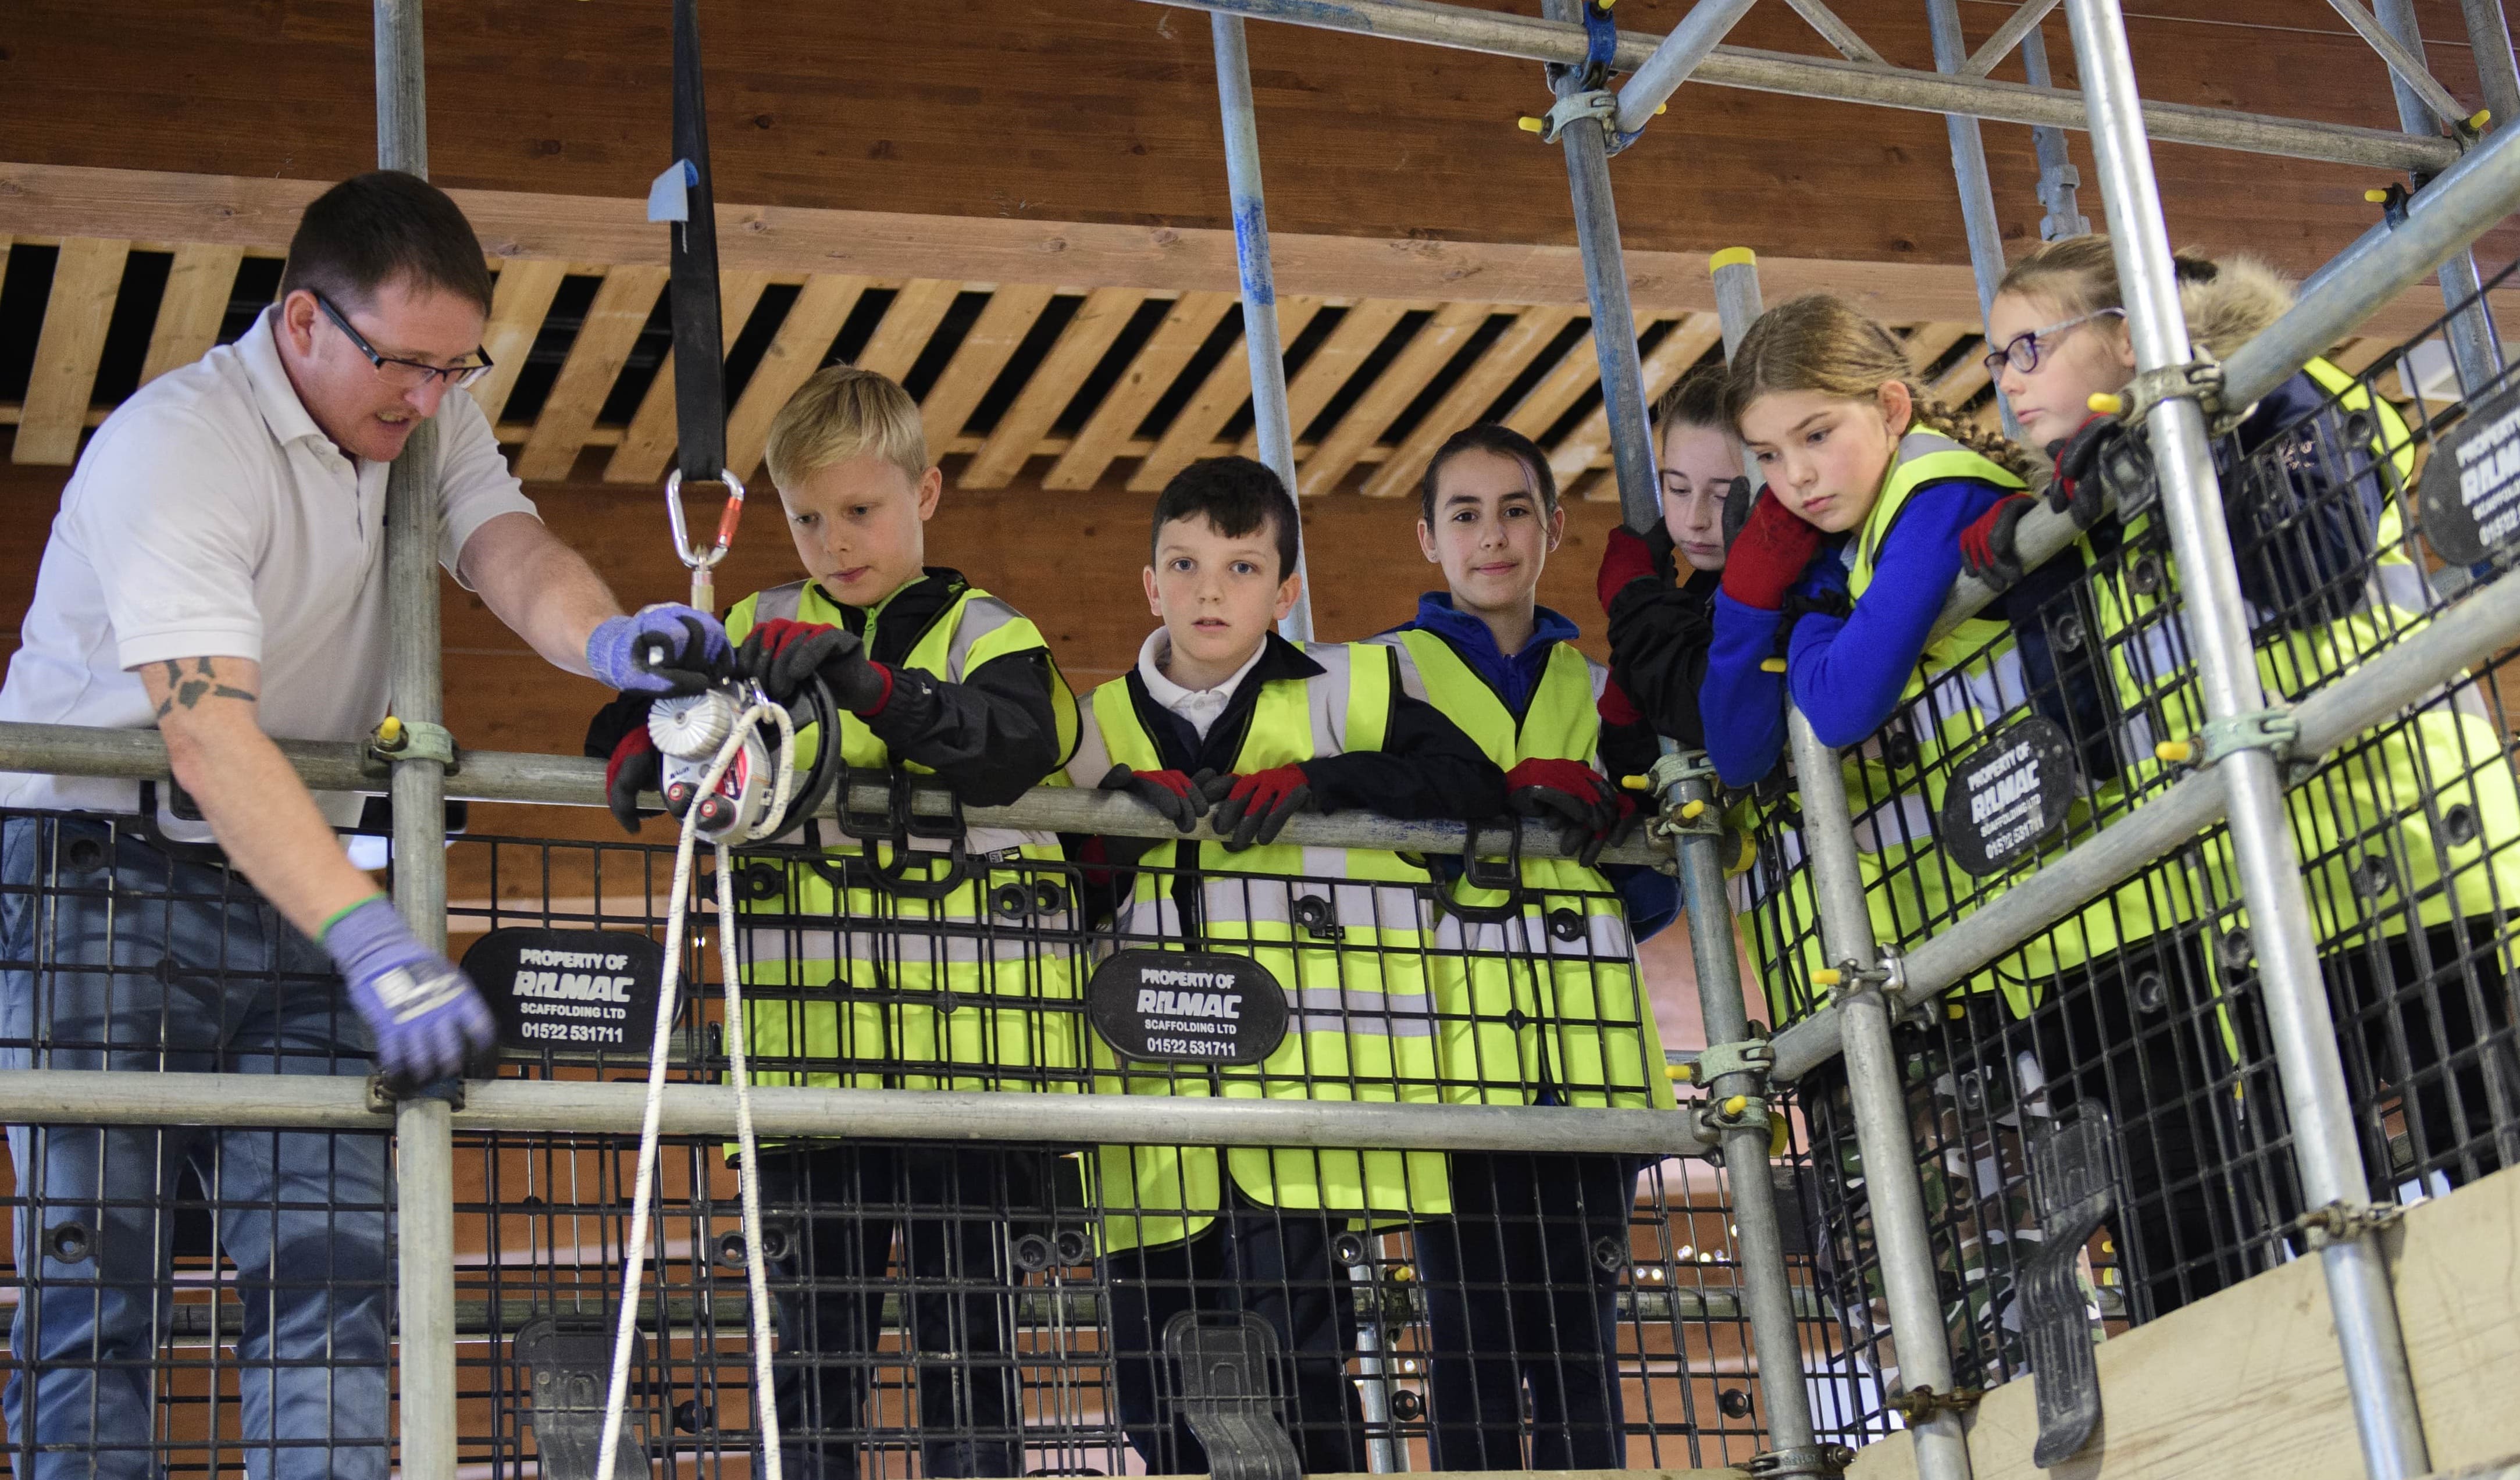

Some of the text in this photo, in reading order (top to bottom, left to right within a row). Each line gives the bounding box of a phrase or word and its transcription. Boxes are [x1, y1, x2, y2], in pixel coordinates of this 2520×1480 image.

[1967, 740, 2030, 791] PROPERTY OF
[1970, 759, 2041, 824] RILMAC
[1980, 793, 2041, 837] SCAFFOLDING LTD
[519, 948, 628, 971] PROPERTY OF
[512, 970, 635, 1003] RILMAC
[1140, 968, 1235, 989] PROPERTY OF
[521, 1003, 626, 1019] SCAFFOLDING LTD
[1136, 989, 1242, 1019] RILMAC
[570, 1025, 623, 1043] 531711
[1145, 1019, 1237, 1035] SCAFFOLDING LTD
[1189, 1041, 1236, 1057] 531711
